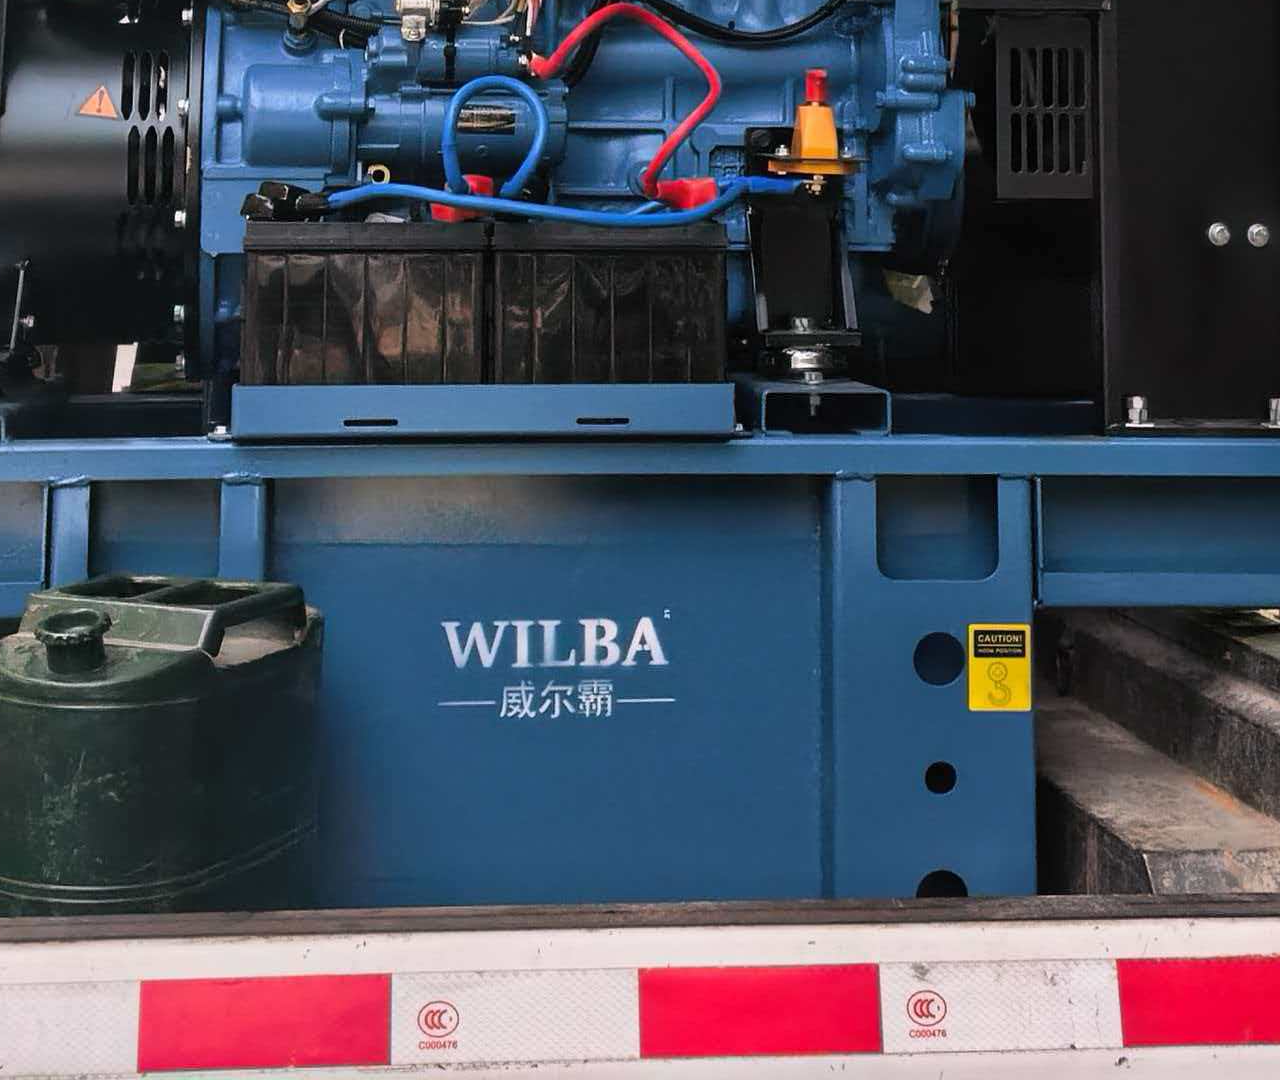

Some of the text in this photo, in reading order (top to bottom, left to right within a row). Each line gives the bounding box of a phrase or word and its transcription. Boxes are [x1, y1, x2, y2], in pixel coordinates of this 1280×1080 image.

[440, 616, 670, 669] WILBA
[977, 634, 1023, 643] CAUTION!
[499, 679, 614, 719] 威尔霸
